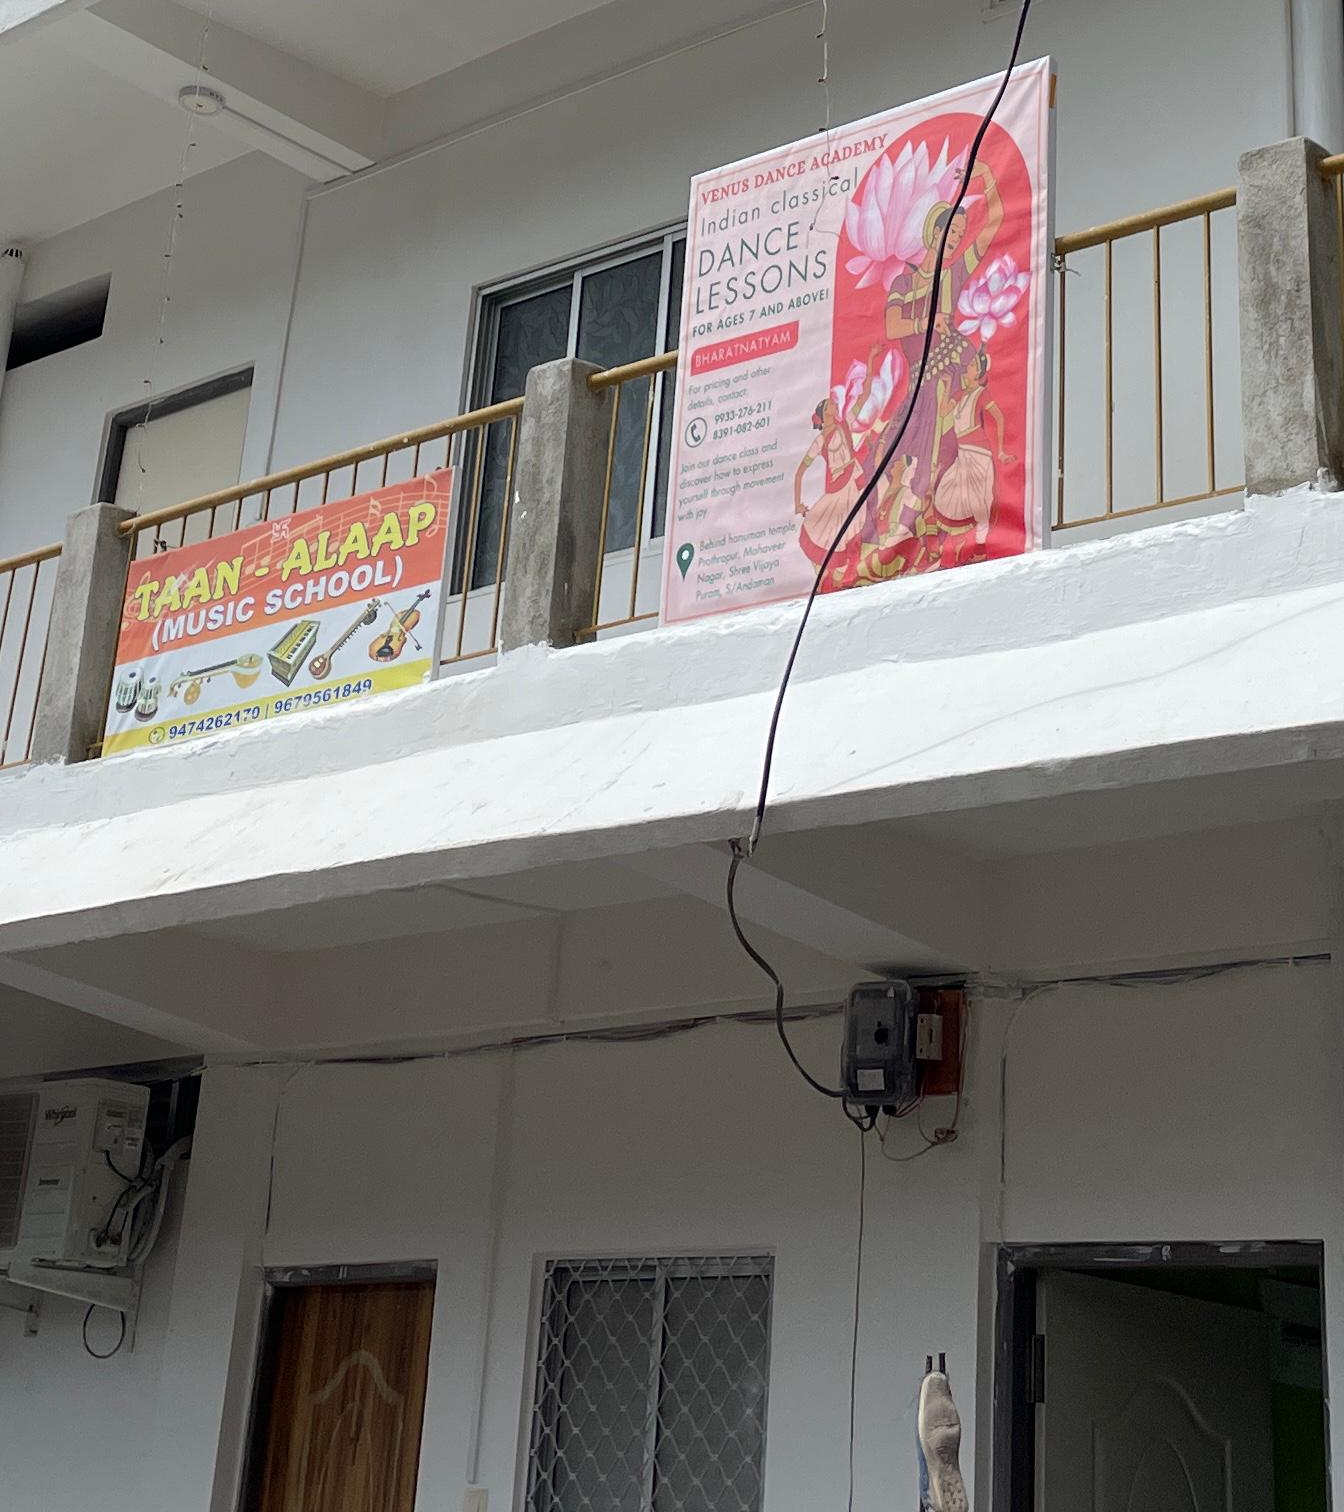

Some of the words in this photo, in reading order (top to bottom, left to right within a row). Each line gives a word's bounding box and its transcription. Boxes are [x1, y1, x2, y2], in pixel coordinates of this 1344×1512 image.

[701, 178, 750, 205] VENUS
[753, 163, 807, 189] DANCE
[809, 133, 888, 172] ACADEMY
[701, 206, 760, 237] Indian
[770, 167, 858, 216] classical
[698, 221, 800, 278] DANCE
[695, 249, 828, 315] LESSONS
[692, 321, 713, 338] FOR
[716, 312, 745, 331] AGES
[749, 309, 755, 321] 7
[759, 301, 784, 319] AND
[694, 331, 792, 369] BHARATNATYAM
[689, 384, 701, 395] For
[732, 369, 749, 383] and
[750, 367, 771, 378] other
[679, 475, 711, 490] discover
[713, 470, 731, 481] how
[733, 467, 742, 476] to
[743, 459, 774, 476] express
[680, 463, 696, 475] Join
[697, 459, 710, 469] our
[712, 453, 737, 465] dance
[739, 446, 759, 459] class
[761, 439, 777, 453] and
[678, 488, 708, 508] yourself
[711, 481, 741, 497] through
[743, 473, 784, 490] movement
[699, 535, 727, 551] Behind
[134, 555, 244, 622] TAAN
[281, 502, 437, 581] ALAAP
[728, 564, 751, 578] Shree
[151, 596, 256, 651] (MUSIC
[263, 555, 404, 617] SCHOOL)
[168, 705, 261, 739] 9474262170
